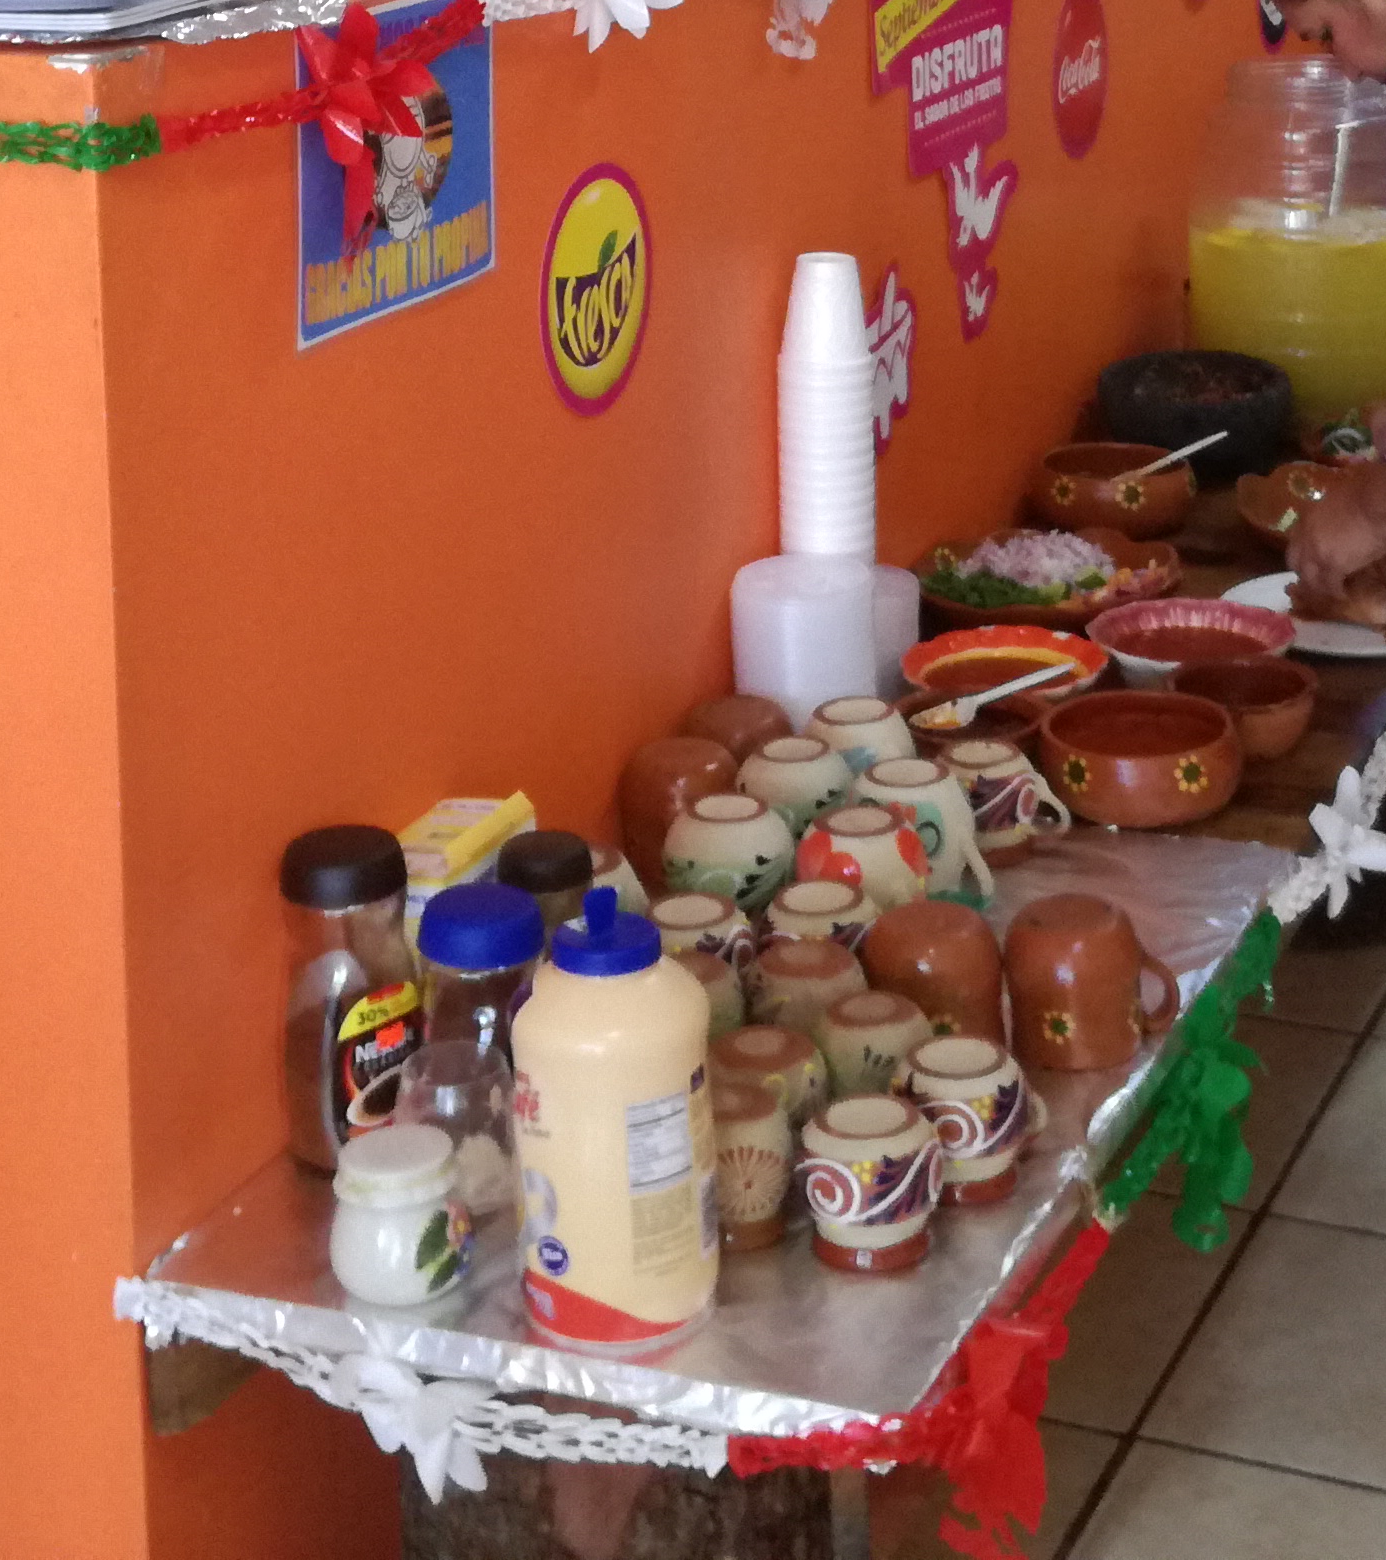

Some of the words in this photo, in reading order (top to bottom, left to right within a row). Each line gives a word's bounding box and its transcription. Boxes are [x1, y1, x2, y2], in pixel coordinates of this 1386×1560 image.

[911, 23, 1004, 103] DISFRUTA
[949, 94, 961, 116] DE
[374, 239, 409, 304] POR
[410, 228, 431, 290] TU
